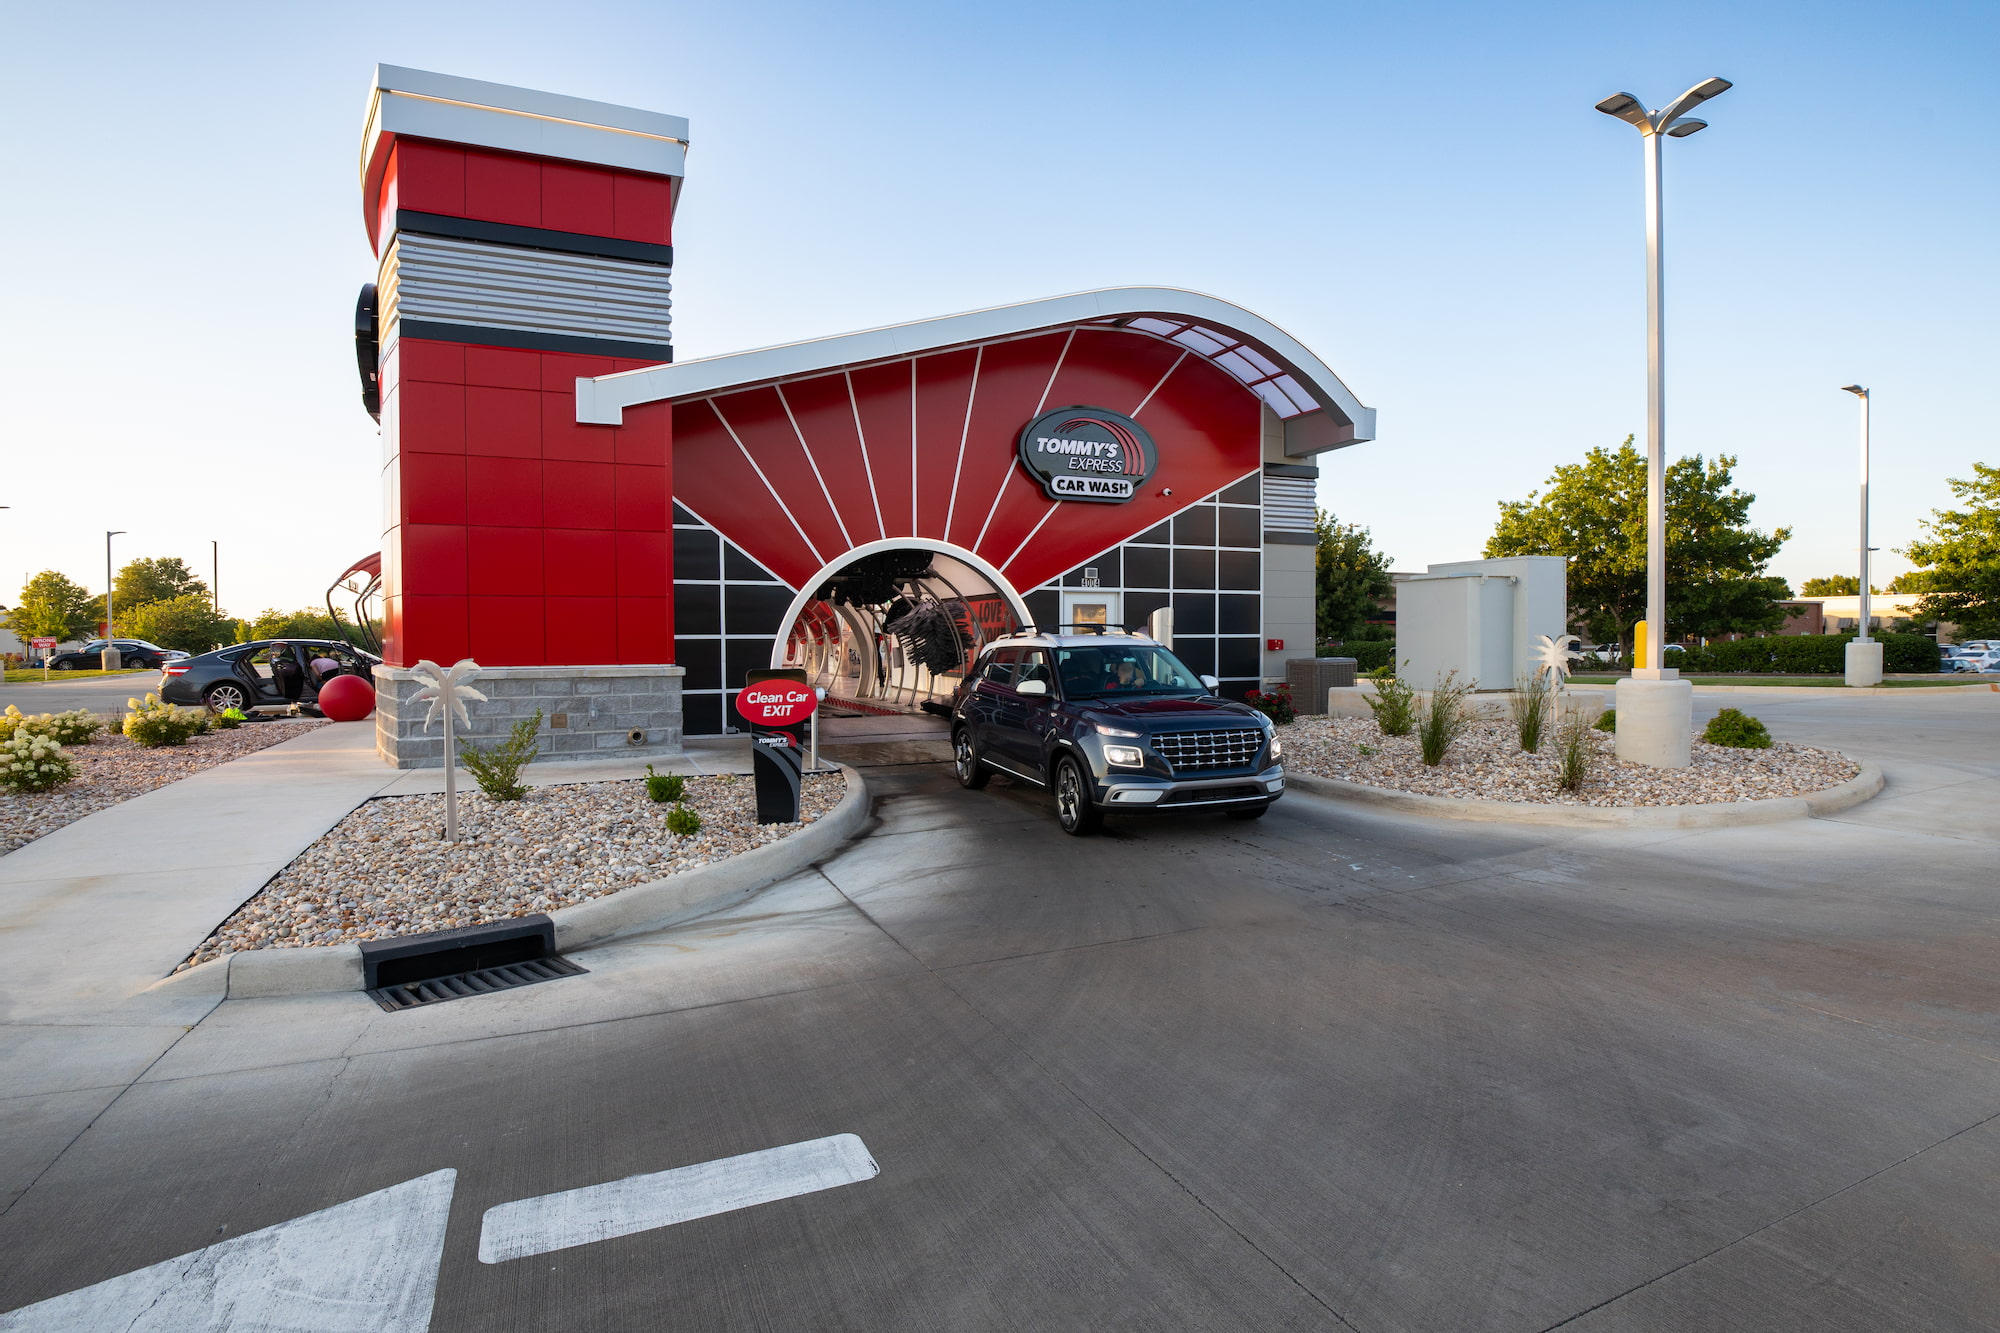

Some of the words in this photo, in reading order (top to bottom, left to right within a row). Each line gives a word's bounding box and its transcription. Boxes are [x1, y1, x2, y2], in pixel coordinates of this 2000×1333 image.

[1036, 437, 1118, 457] TOMMY'S
[1068, 457, 1122, 472] EXPRESS
[1056, 479, 1085, 492] CAR
[1088, 481, 1128, 494] WASH
[1081, 578, 1100, 587] 4004
[979, 601, 1002, 623] LOVE
[747, 691, 783, 704] Clean
[786, 691, 808, 703] Car
[762, 705, 794, 717] EXIT
